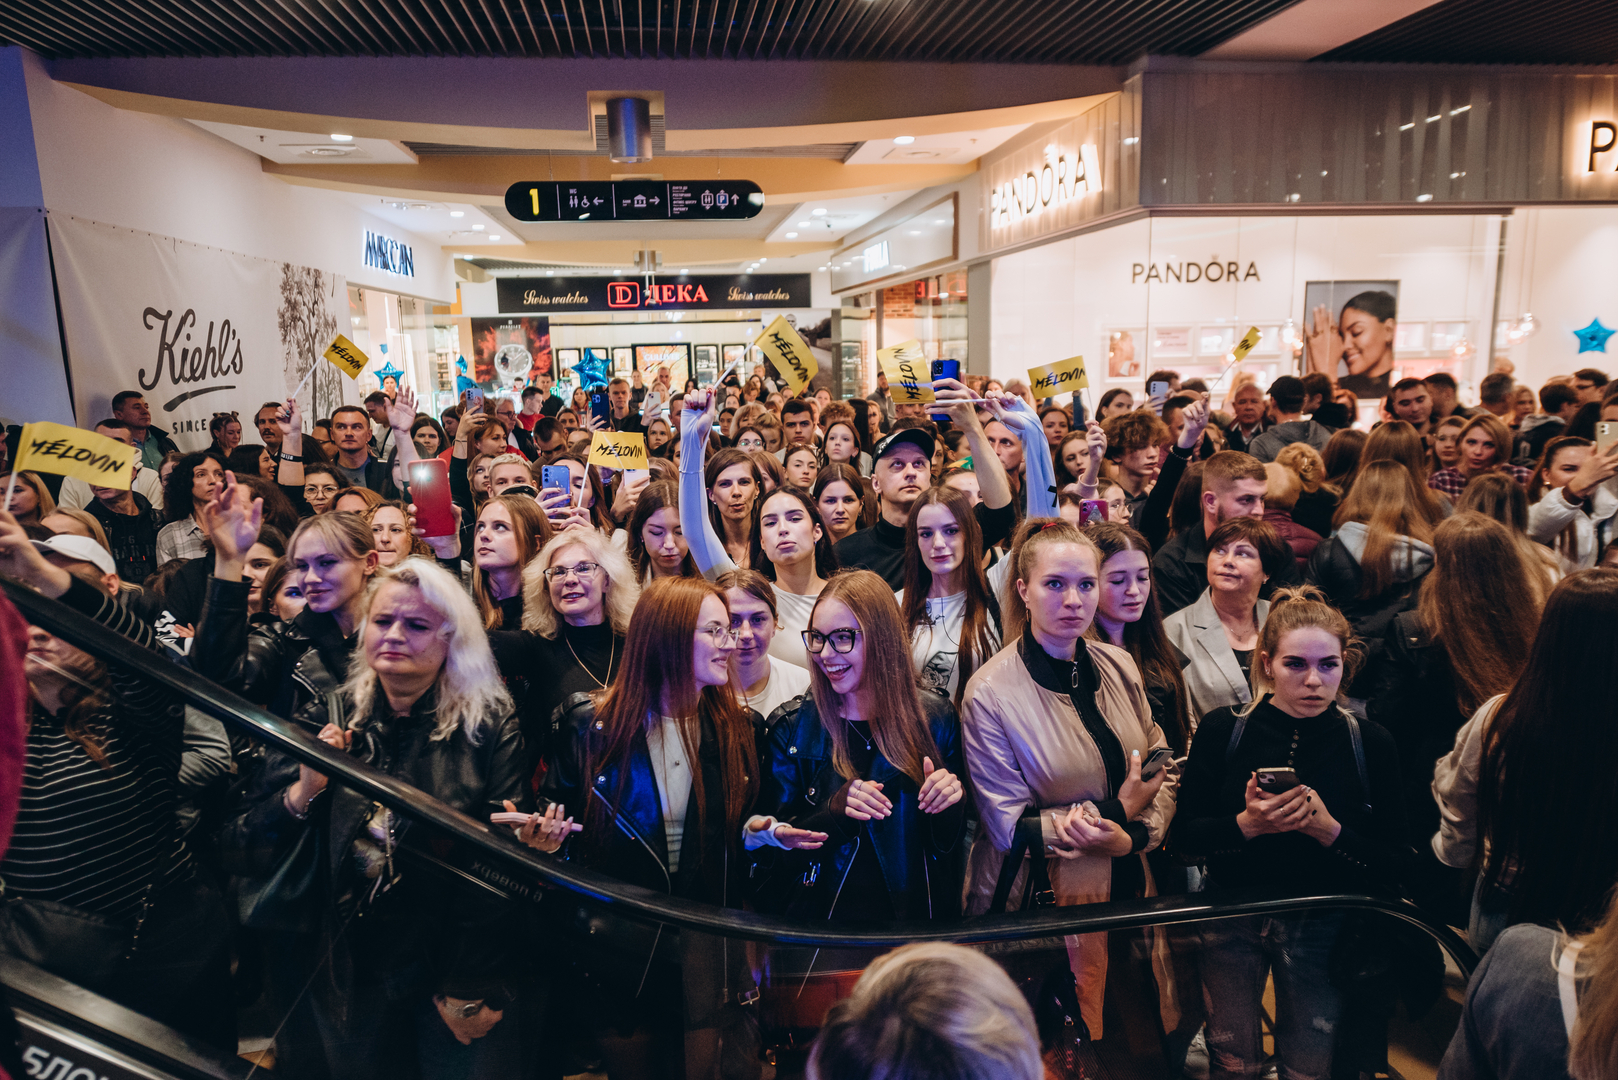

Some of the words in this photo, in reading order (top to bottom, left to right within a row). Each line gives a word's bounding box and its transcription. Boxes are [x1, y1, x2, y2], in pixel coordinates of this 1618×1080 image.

[1588, 121, 1618, 172] P
[991, 145, 1103, 228] PANDORA
[529, 188, 540, 216] 1
[1131, 260, 1261, 284] PANDORA
[523, 289, 551, 305] Swiss
[551, 290, 589, 304] watches
[645, 284, 709, 307] ДЕКА
[727, 286, 754, 301] Swiss
[754, 287, 790, 300] watches
[138, 306, 243, 391] Kiehl's
[172, 418, 207, 435] SINCE
[595, 441, 643, 458] MÉLOVIN
